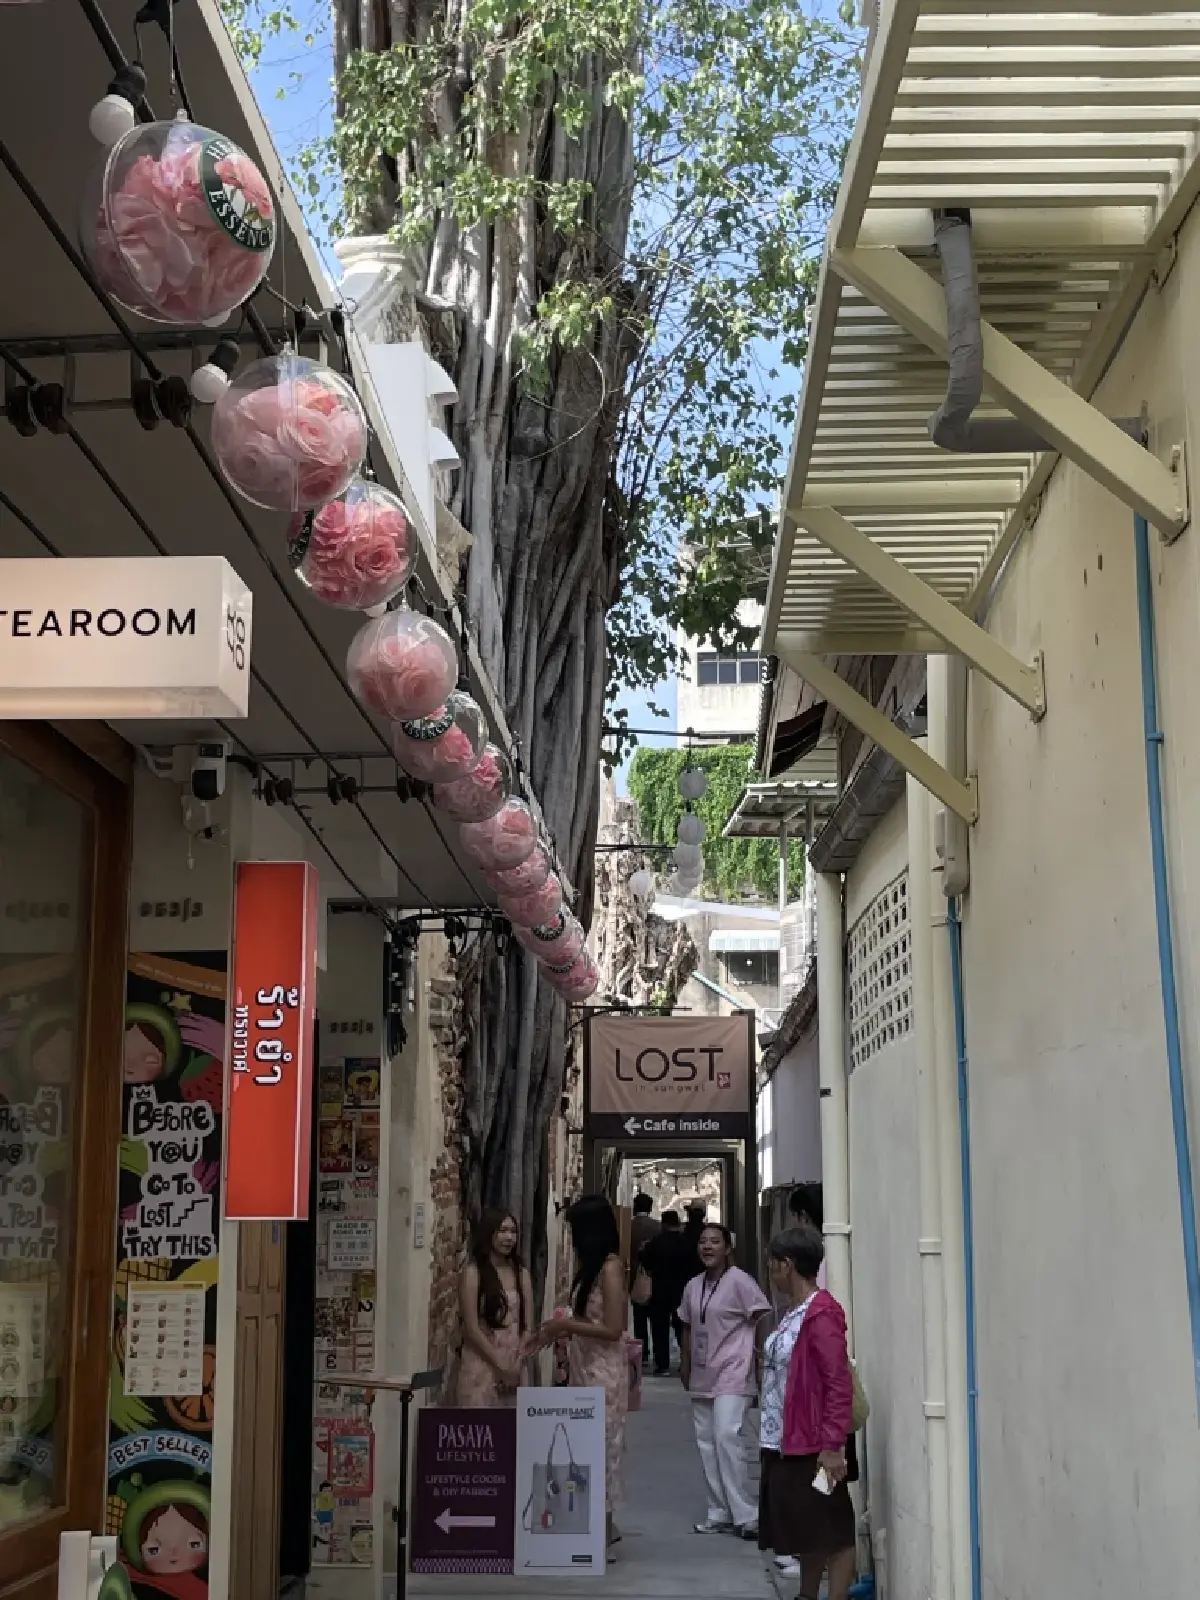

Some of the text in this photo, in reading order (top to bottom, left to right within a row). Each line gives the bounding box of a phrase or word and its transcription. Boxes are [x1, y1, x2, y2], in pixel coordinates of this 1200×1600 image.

[208, 190, 275, 248] ESSENC
[615, 1048, 724, 1082] LOST
[643, 1118, 720, 1131] Cafe inside
[125, 1234, 212, 1257] TRY THIS
[438, 1424, 494, 1449] PASAYA
[113, 1436, 210, 1465] BEST SELLER
[436, 1451, 496, 1462] LIFESTYLE
[425, 1474, 470, 1484] LIFESTYLE
